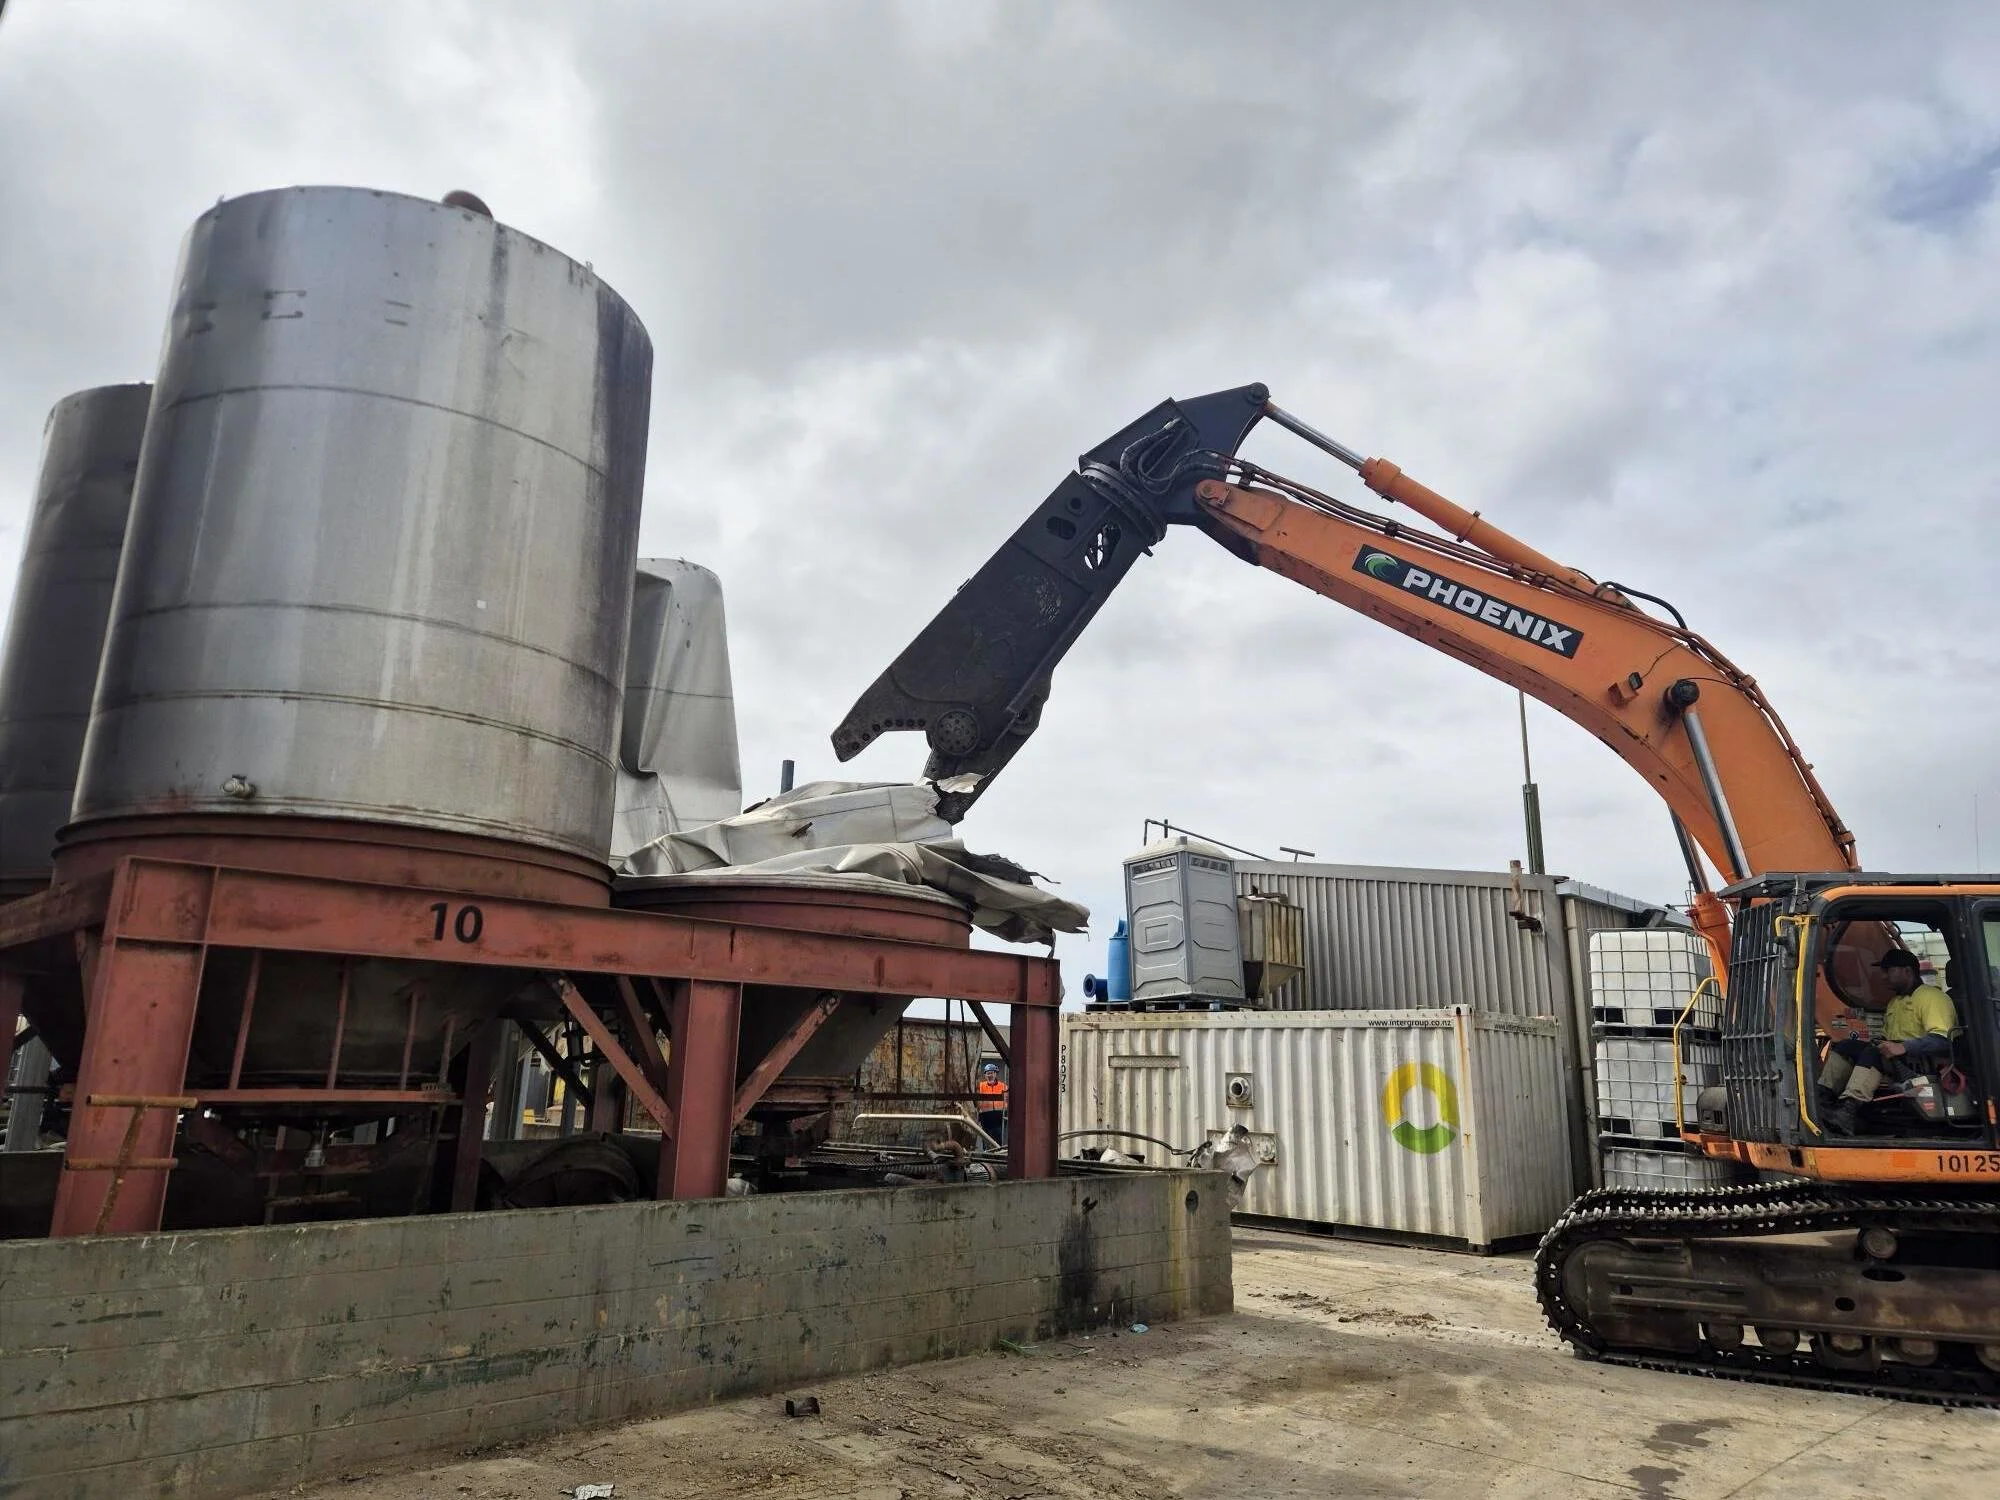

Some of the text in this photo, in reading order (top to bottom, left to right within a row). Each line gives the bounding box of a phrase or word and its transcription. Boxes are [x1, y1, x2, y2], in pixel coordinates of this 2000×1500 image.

[1402, 567, 1573, 651] PHOENIX
[430, 902, 483, 944] 10
[1368, 1019, 1451, 1030] www.intergroup.co.nz
[1937, 1154, 2000, 1172] 10125
